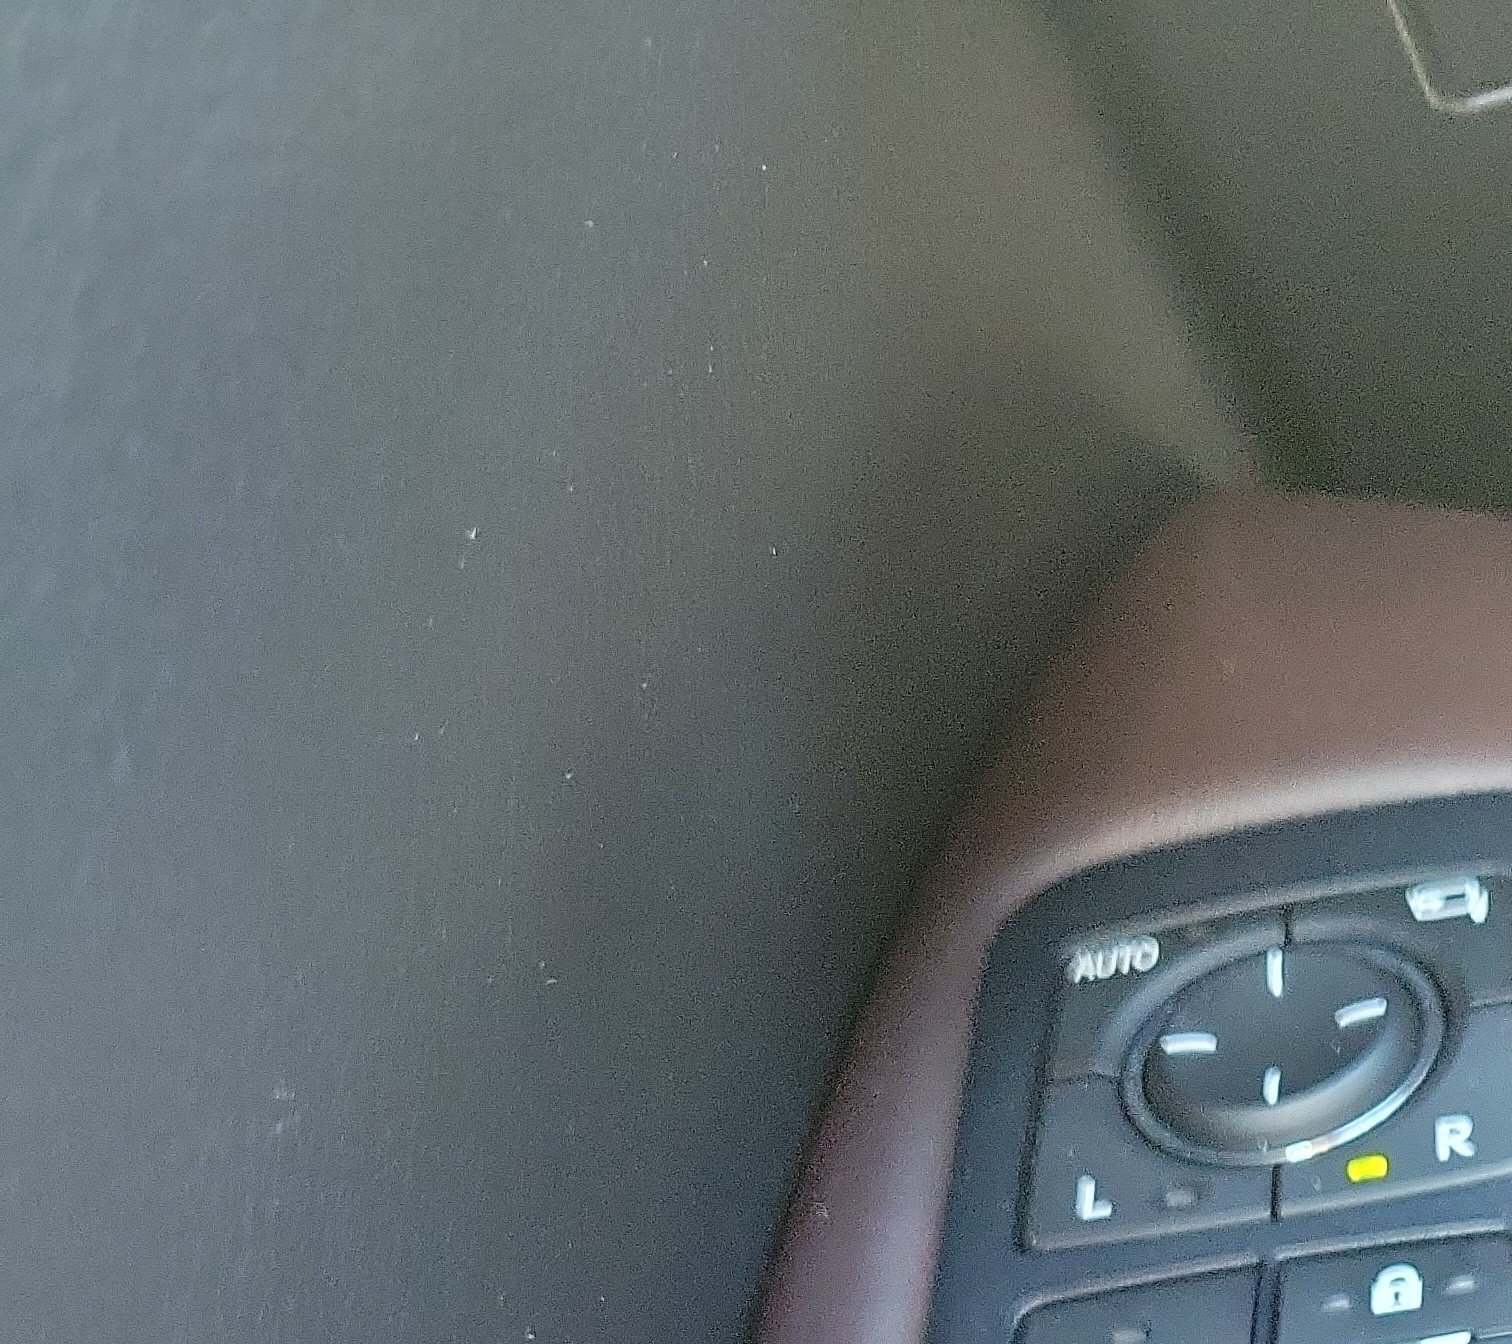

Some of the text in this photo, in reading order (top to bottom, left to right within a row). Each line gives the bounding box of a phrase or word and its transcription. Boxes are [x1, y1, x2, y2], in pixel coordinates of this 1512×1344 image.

[1067, 936, 1160, 983] AUTO
[1434, 1114, 1475, 1163] R
[1076, 1175, 1113, 1221] L
